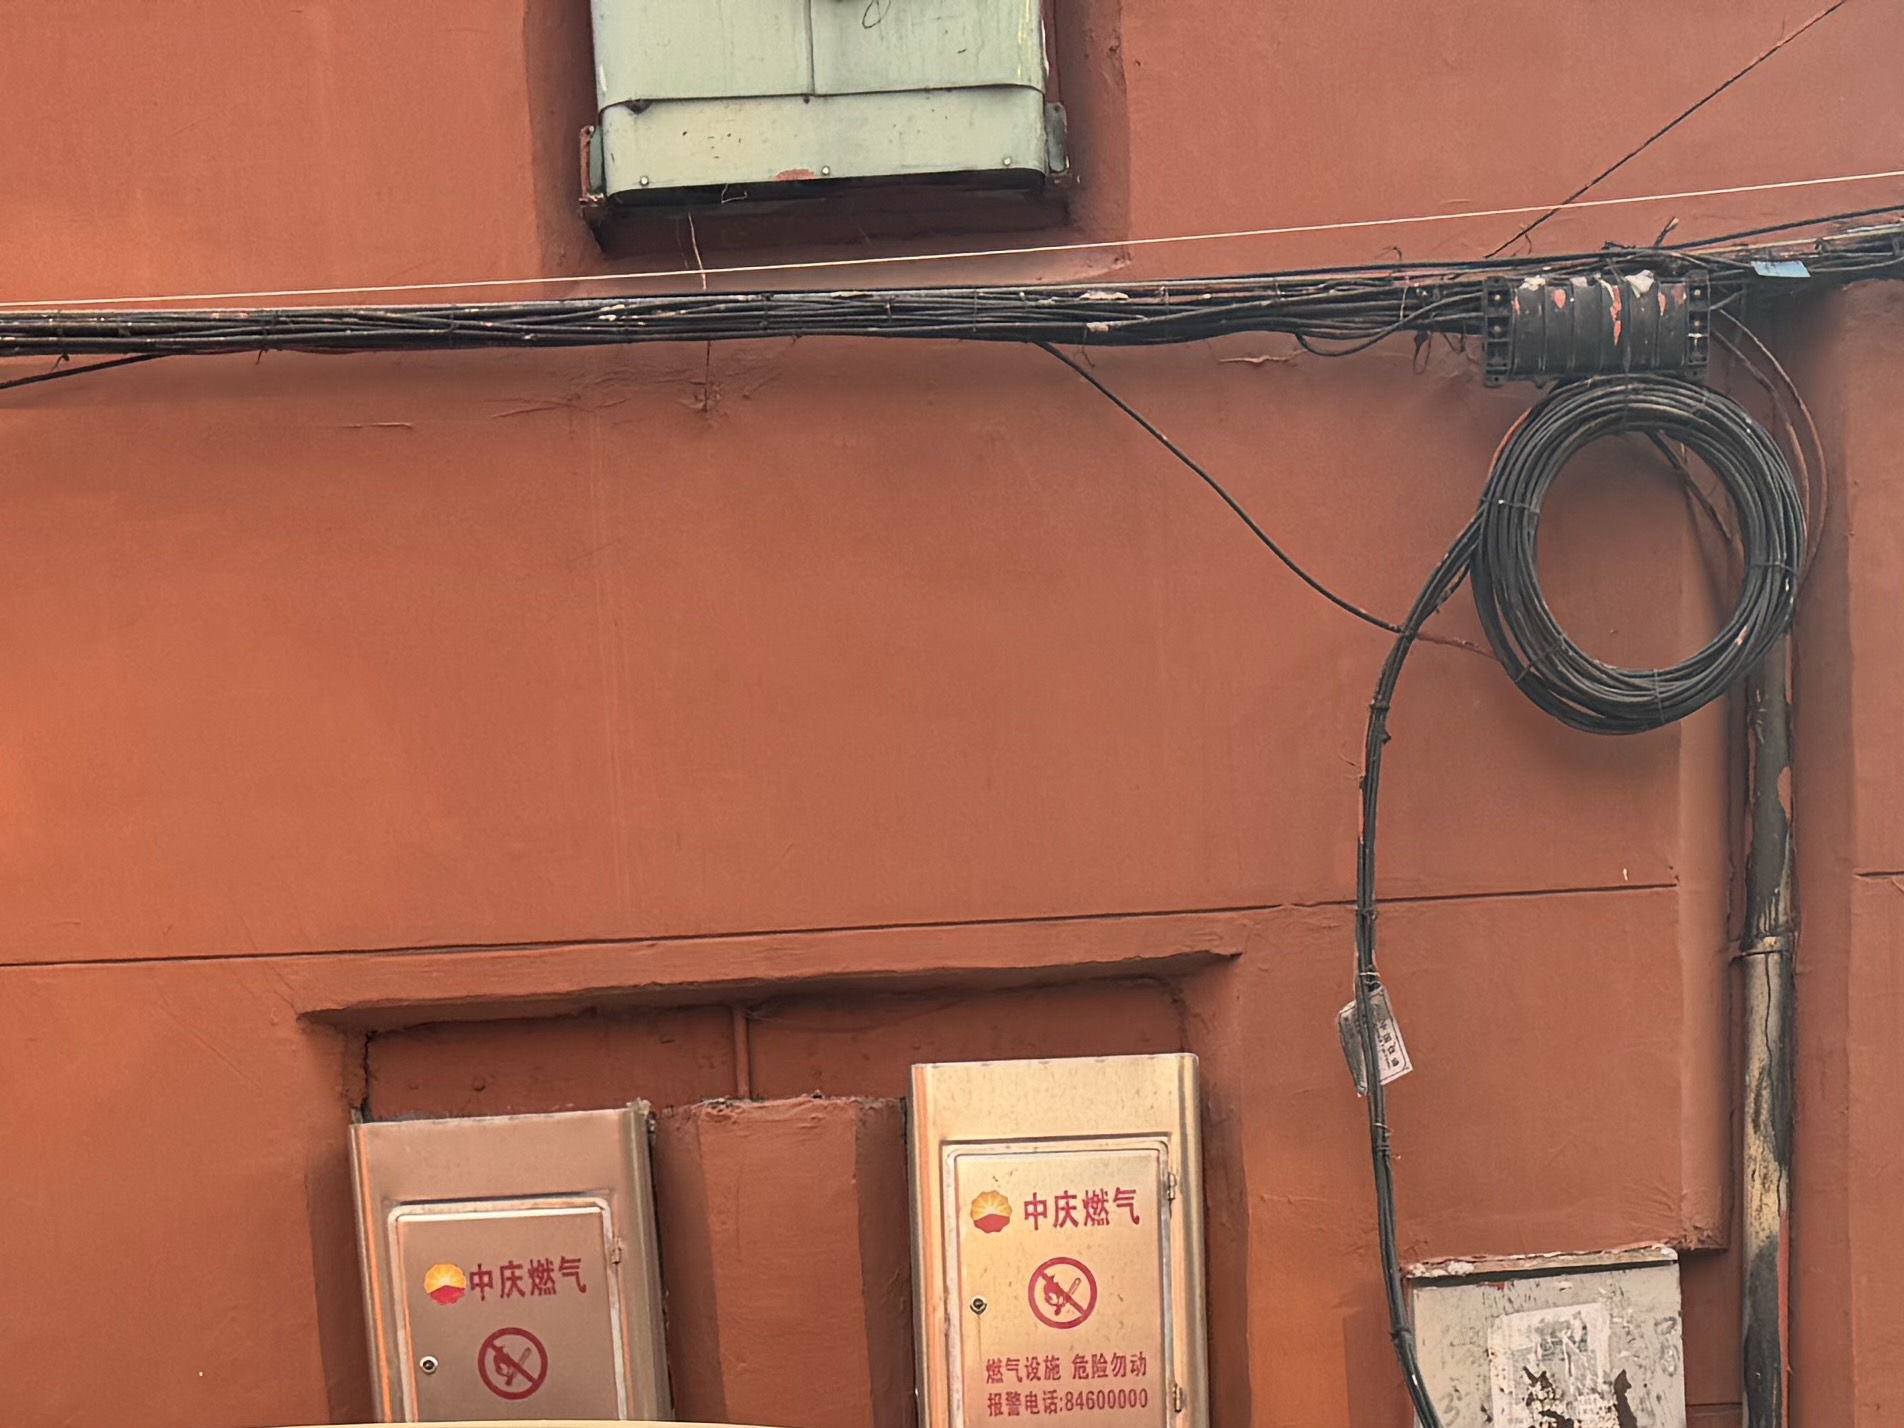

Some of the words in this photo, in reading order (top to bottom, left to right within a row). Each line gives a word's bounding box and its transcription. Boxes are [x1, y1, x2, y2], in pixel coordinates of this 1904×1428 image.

[1024, 1187, 1140, 1231] 中庆燃气
[469, 1256, 587, 1301] 中庆燃气
[986, 1355, 1062, 1384] 燃气设施
[1071, 1351, 1147, 1380] 危险勿动
